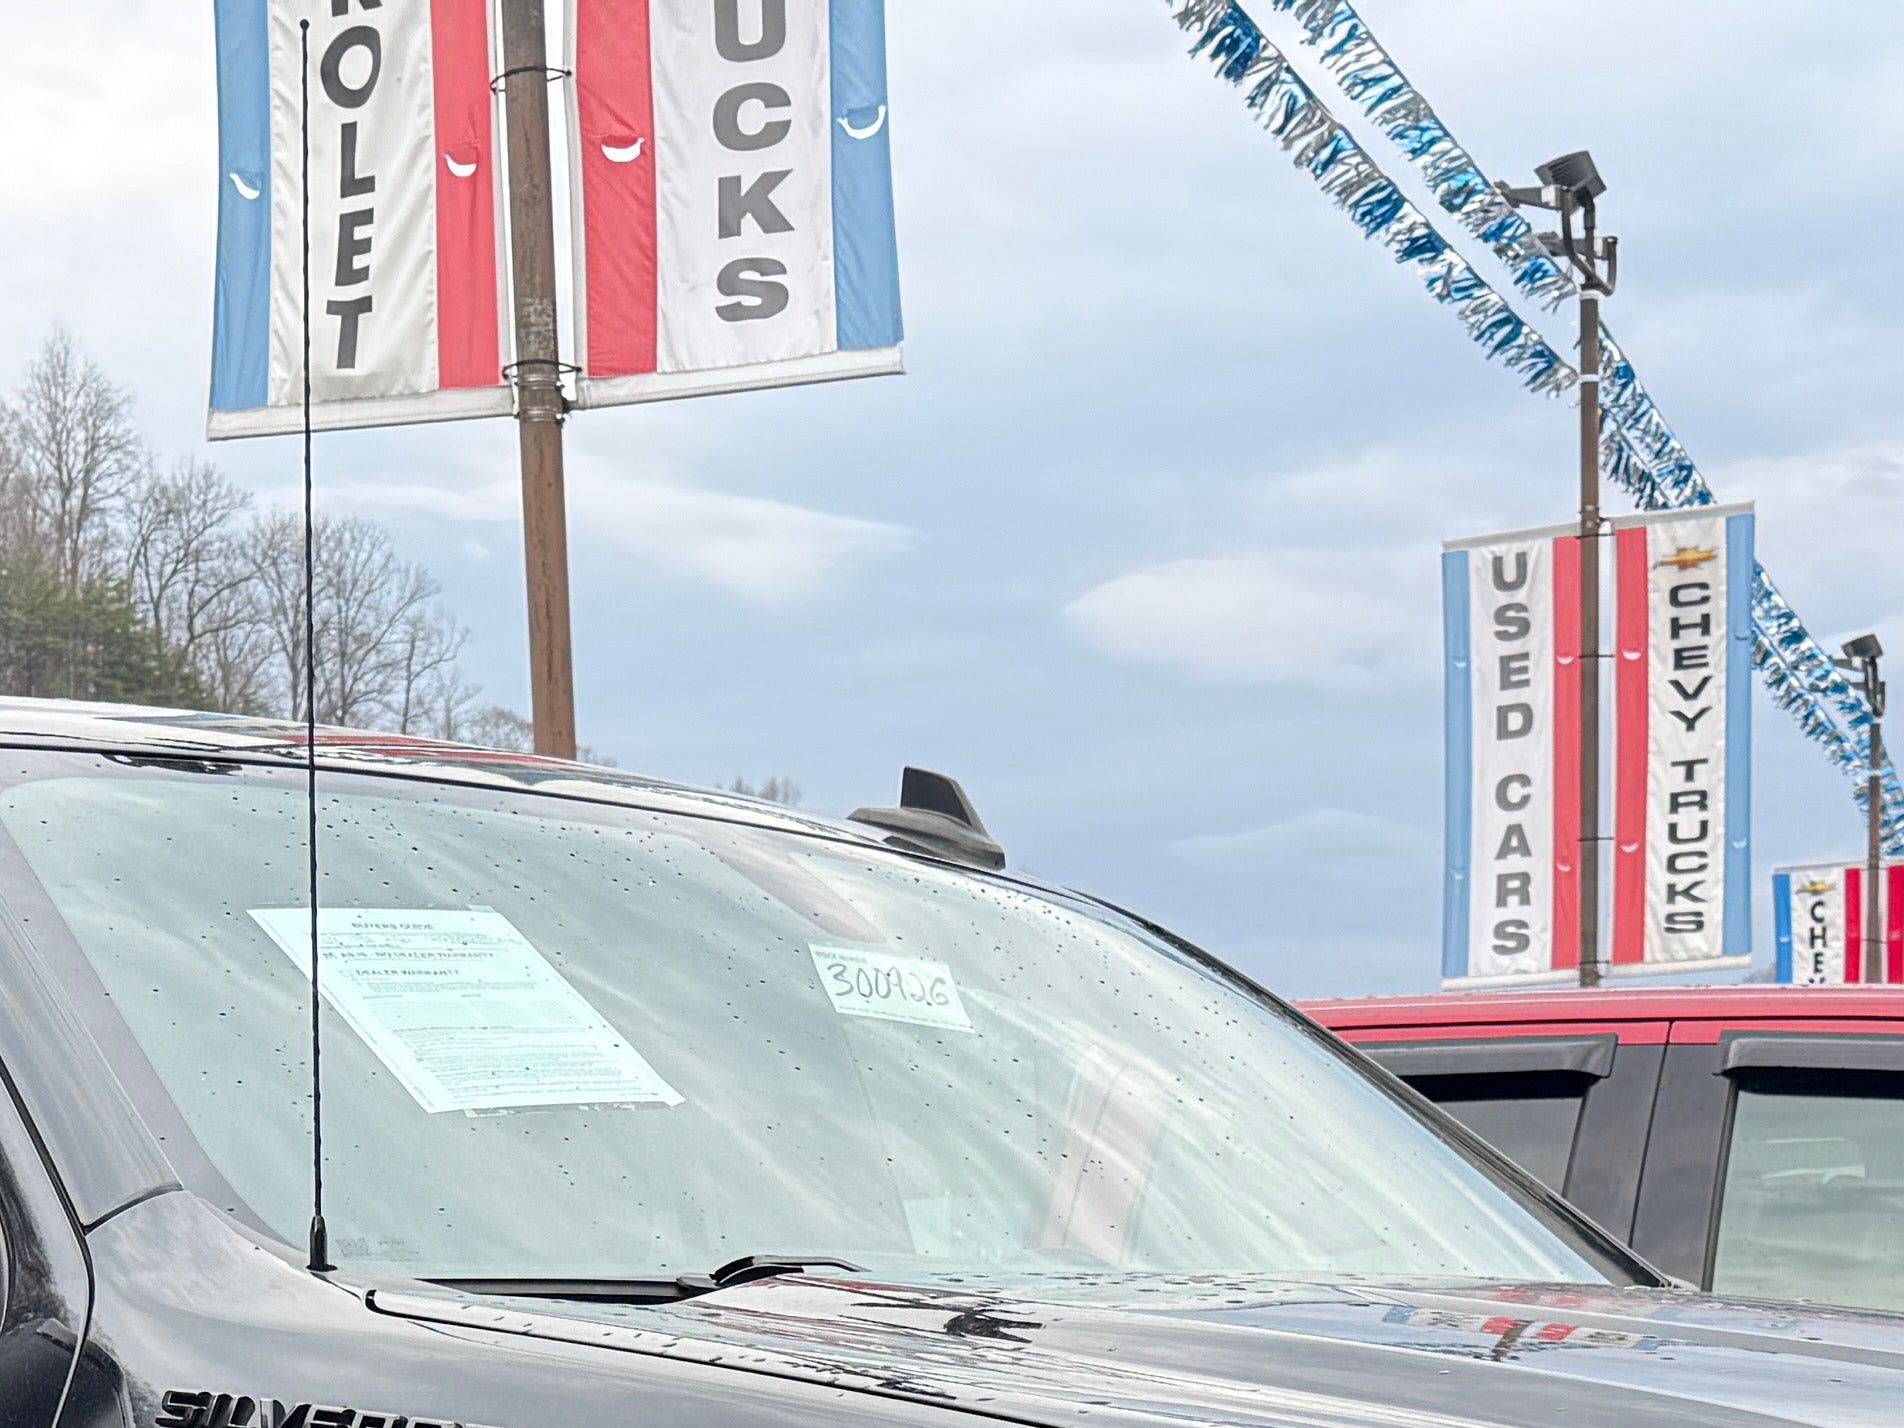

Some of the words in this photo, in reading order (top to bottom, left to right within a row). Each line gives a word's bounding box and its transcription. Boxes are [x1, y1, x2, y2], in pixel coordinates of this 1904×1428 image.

[320, 0, 383, 370] OLET
[712, 0, 794, 323] UCKS
[1492, 551, 1533, 741] USED
[1668, 582, 1711, 733] CHEVY
[1492, 773, 1533, 956] CARS
[1664, 757, 1710, 935] TRUCKS
[1808, 900, 1828, 984] CHE
